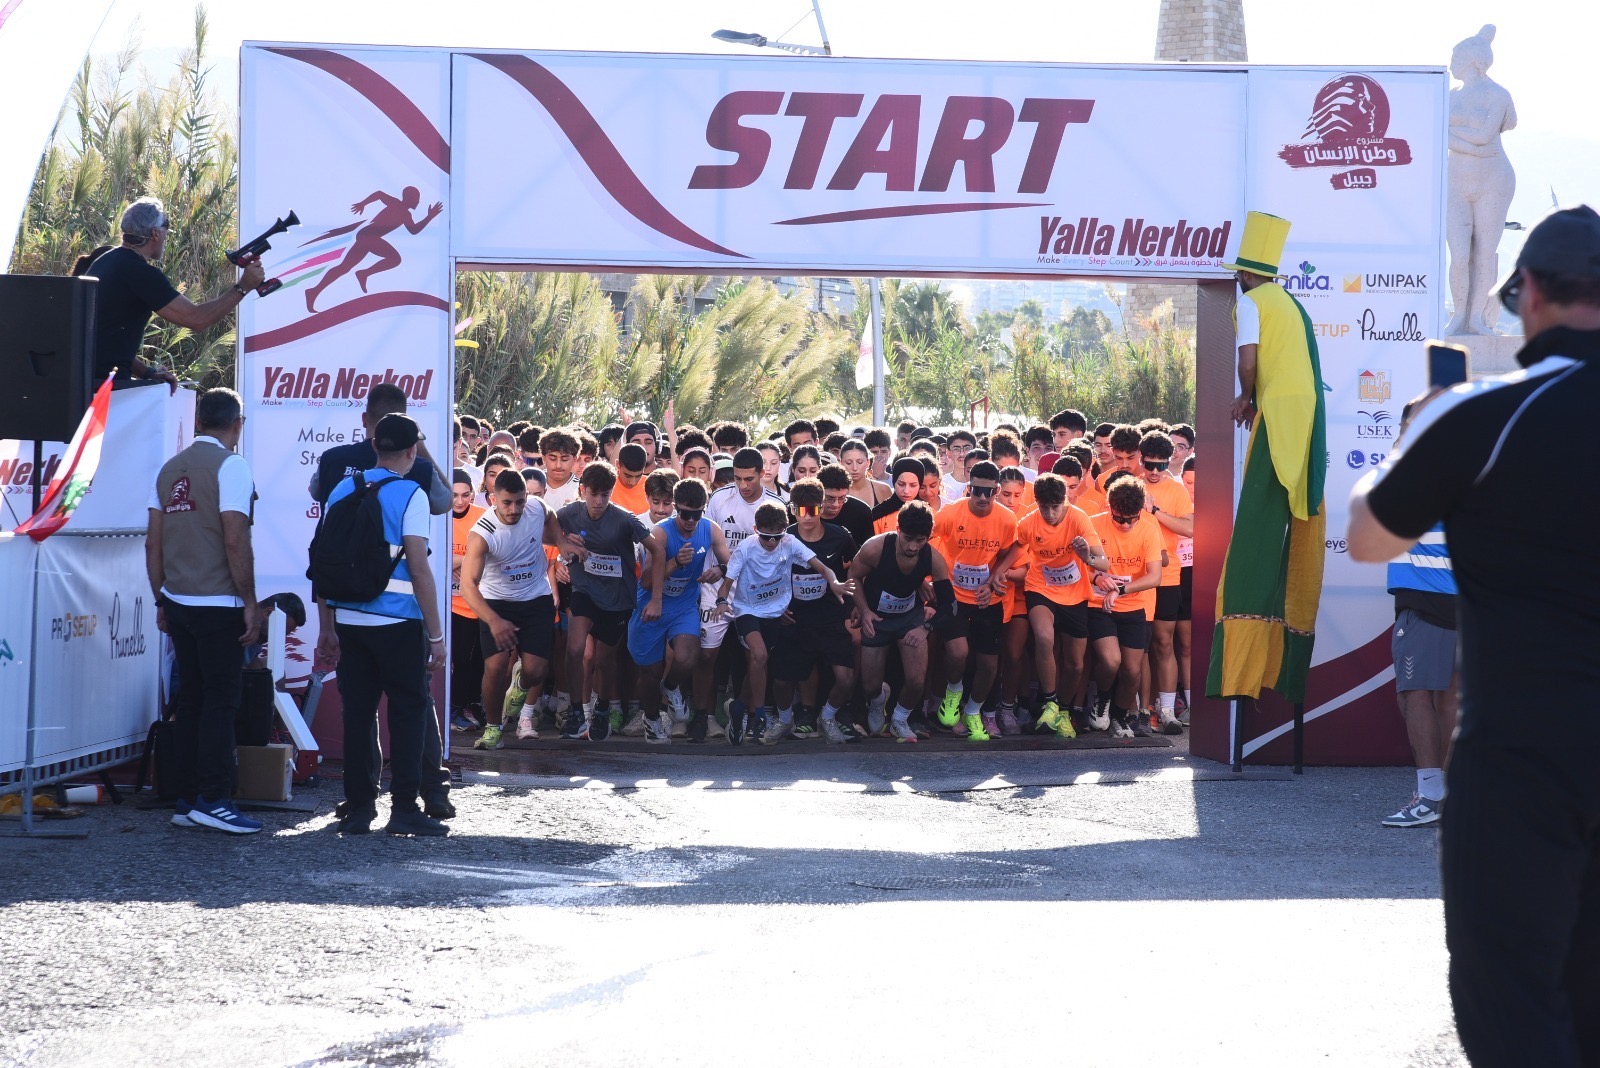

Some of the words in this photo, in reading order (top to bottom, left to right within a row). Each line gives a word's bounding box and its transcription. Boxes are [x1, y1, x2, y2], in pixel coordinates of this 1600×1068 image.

[687, 91, 1095, 194] START
[1357, 135, 1384, 145] مشروع
[1362, 146, 1397, 162] وطن
[1343, 173, 1372, 187] جبيل
[1038, 216, 1115, 255] Yalla
[1117, 218, 1232, 258] Nerkod
[1037, 256, 1060, 264] Make
[1088, 257, 1106, 267] Step
[1109, 257, 1133, 266] Count
[1366, 273, 1427, 288] UNIPAK
[1313, 323, 1350, 337] ETUP
[1357, 308, 1426, 342] Prunelle
[263, 366, 331, 398] Yalla
[306, 400, 324, 408] Step
[297, 427, 345, 442] Make
[1357, 425, 1393, 436] USEK
[1039, 543, 1074, 556] ATLETIC
[591, 561, 614, 572] 3004
[509, 571, 533, 582] 3056
[958, 575, 981, 585] 3111
[1050, 573, 1074, 583] 3114
[756, 587, 780, 600] 3067
[800, 585, 822, 595] 3062
[108, 592, 147, 660] Prunelle
